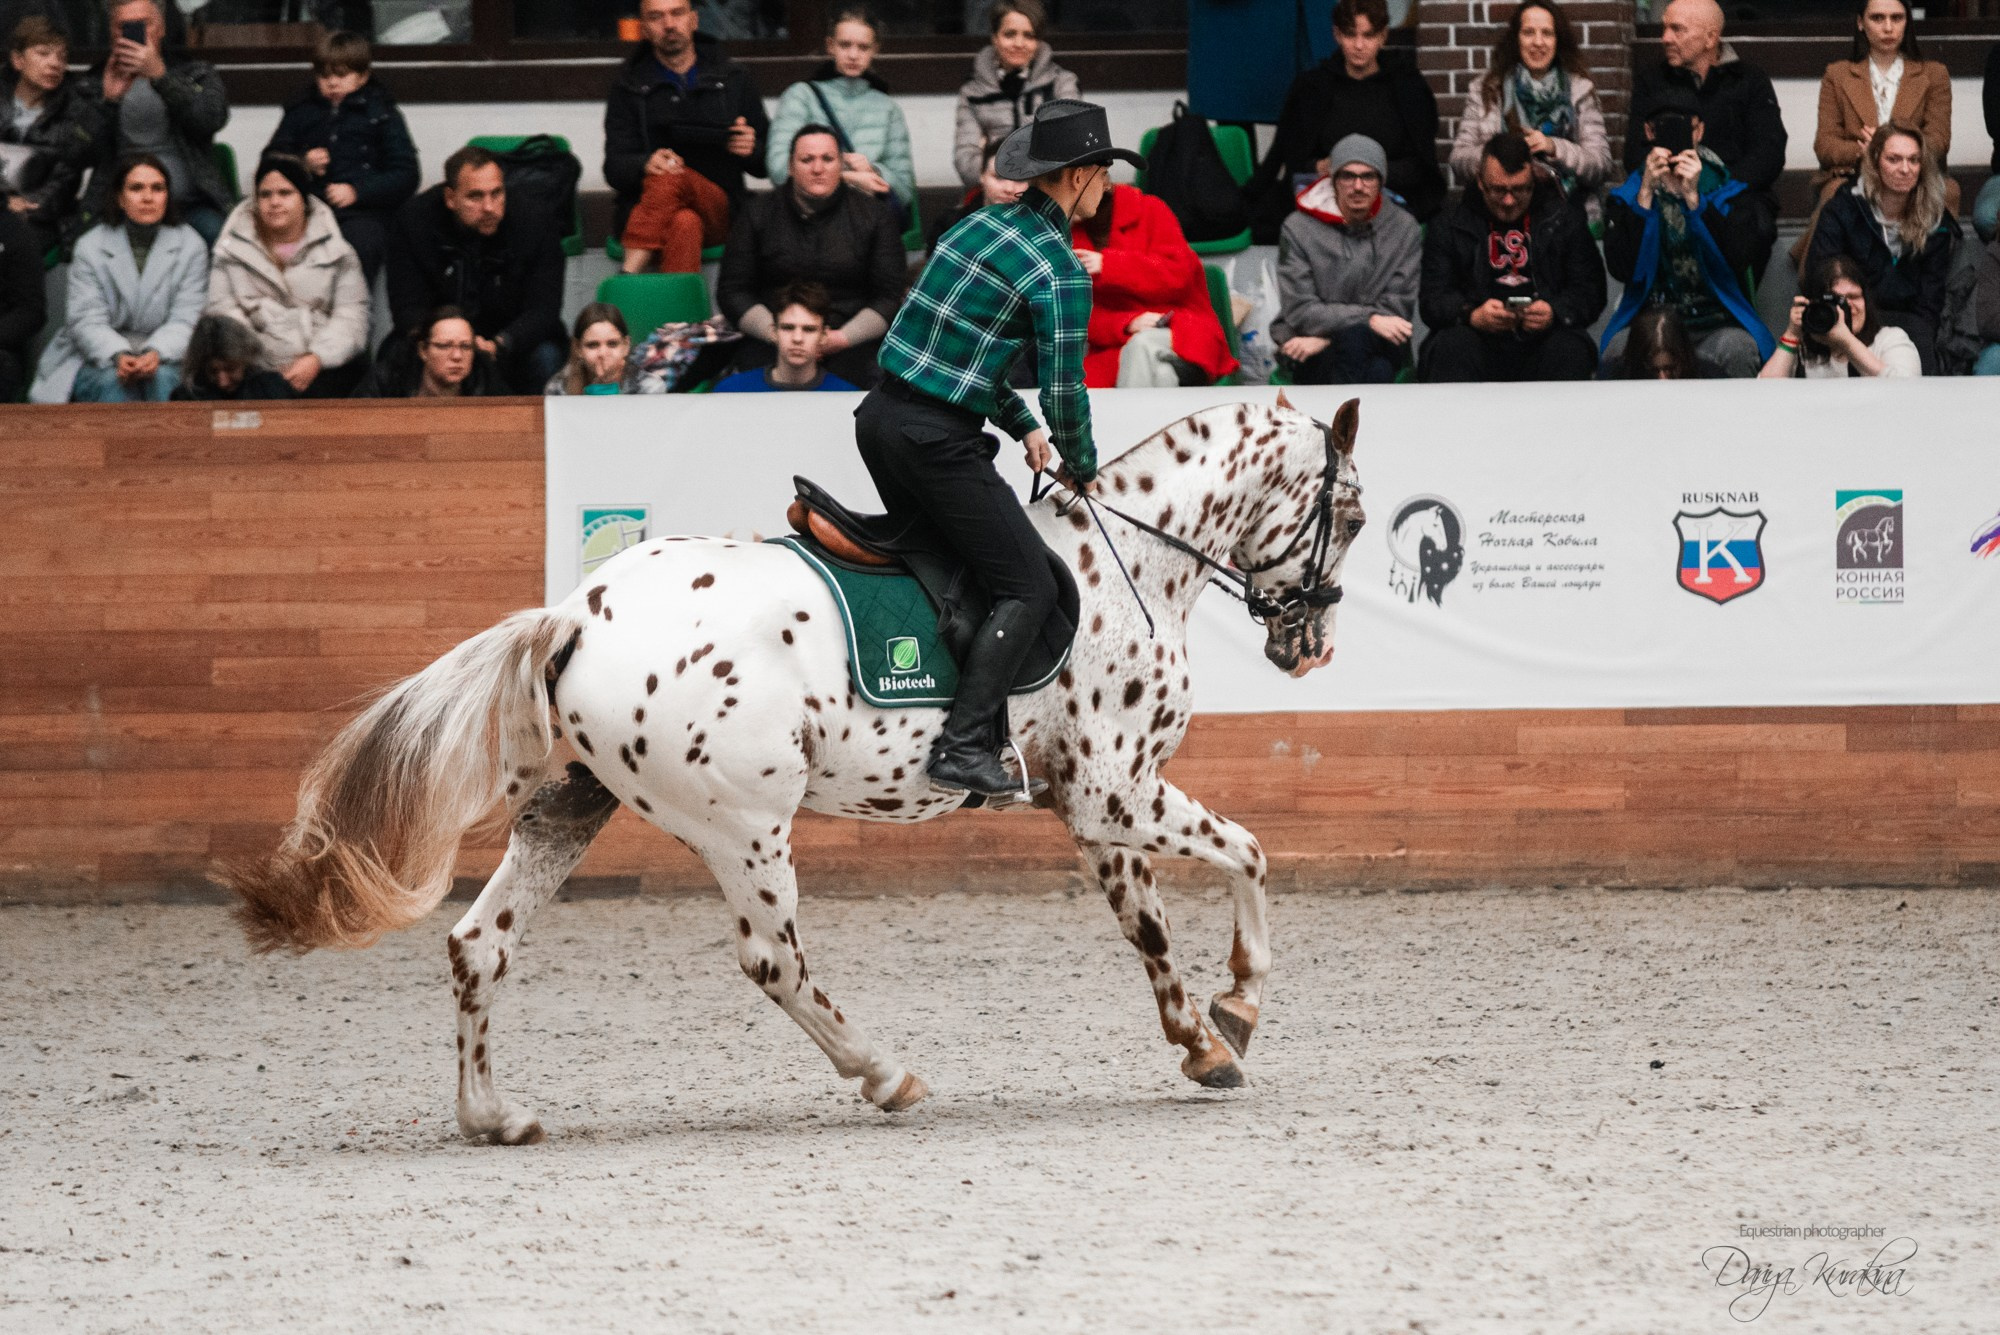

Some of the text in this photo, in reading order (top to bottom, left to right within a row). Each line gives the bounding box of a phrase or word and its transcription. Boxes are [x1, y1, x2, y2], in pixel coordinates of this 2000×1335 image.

[1682, 491, 1760, 504] RUSKNAB
[1489, 510, 1586, 527] Мастерская
[1478, 532, 1598, 548] Ночная Кобыла
[1470, 560, 1531, 575] Украшения
[1472, 581, 1484, 592] из
[1488, 578, 1516, 588] волос
[1521, 576, 1557, 588] Вашей
[1836, 571, 1905, 583] КОННАЯ
[1836, 587, 1905, 599] РОССИЯ
[879, 674, 936, 692] Biotech
